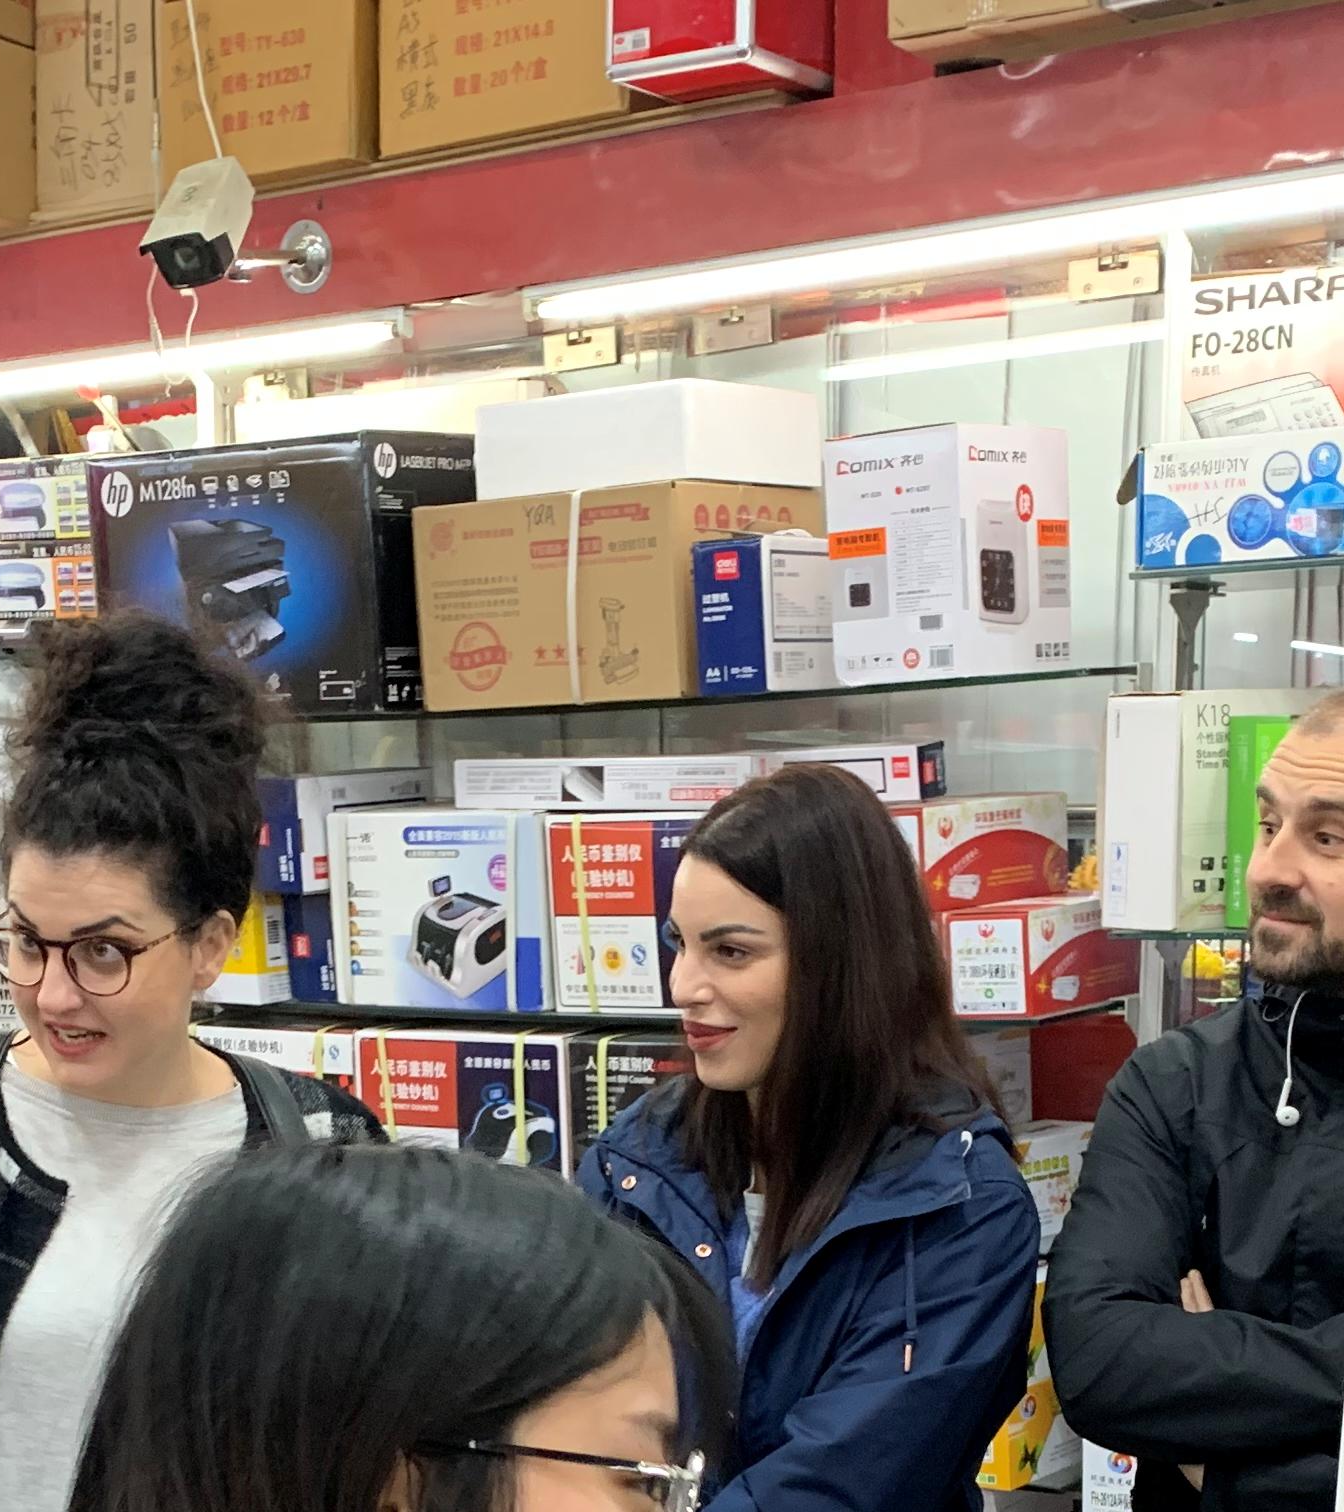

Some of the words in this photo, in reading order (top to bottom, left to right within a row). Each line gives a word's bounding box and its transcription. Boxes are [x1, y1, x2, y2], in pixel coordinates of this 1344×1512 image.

[1191, 323, 1294, 359] FO-28CN
[375, 443, 396, 478] hp
[400, 455, 435, 470] LASERJET
[104, 472, 131, 517] hp
[139, 475, 197, 502] M128fn
[1196, 703, 1231, 727] K18
[1196, 759, 1220, 769] Time
[585, 1055, 654, 1073] 人币鉴别仪
